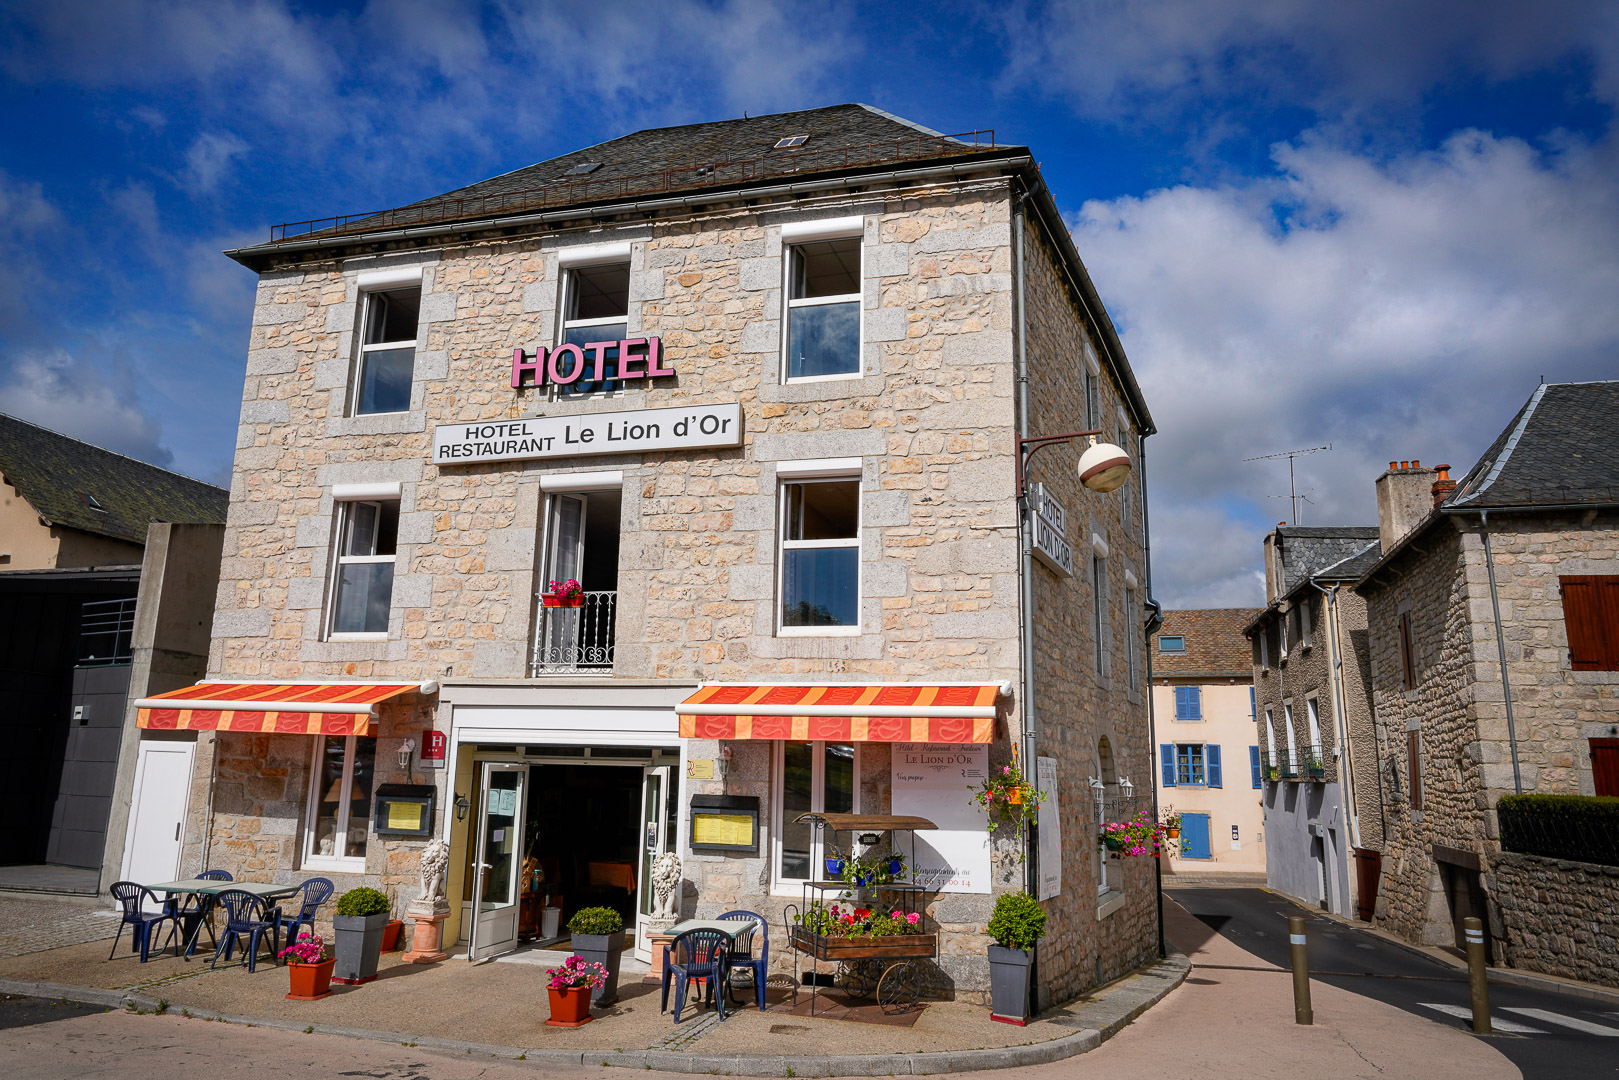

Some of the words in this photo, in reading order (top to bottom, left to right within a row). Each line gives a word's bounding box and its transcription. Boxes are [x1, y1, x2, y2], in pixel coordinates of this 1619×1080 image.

[511, 336, 676, 388] HOTEL
[465, 423, 534, 440] HOTEL
[565, 425, 595, 444] Le
[607, 420, 660, 442] Lion
[673, 414, 731, 437] d'Or
[439, 437, 555, 459] RESTAURANT
[1043, 492, 1064, 533] HOTEL
[1037, 518, 1054, 556] LION
[1054, 536, 1071, 573] D'OR
[432, 736, 443, 747] H
